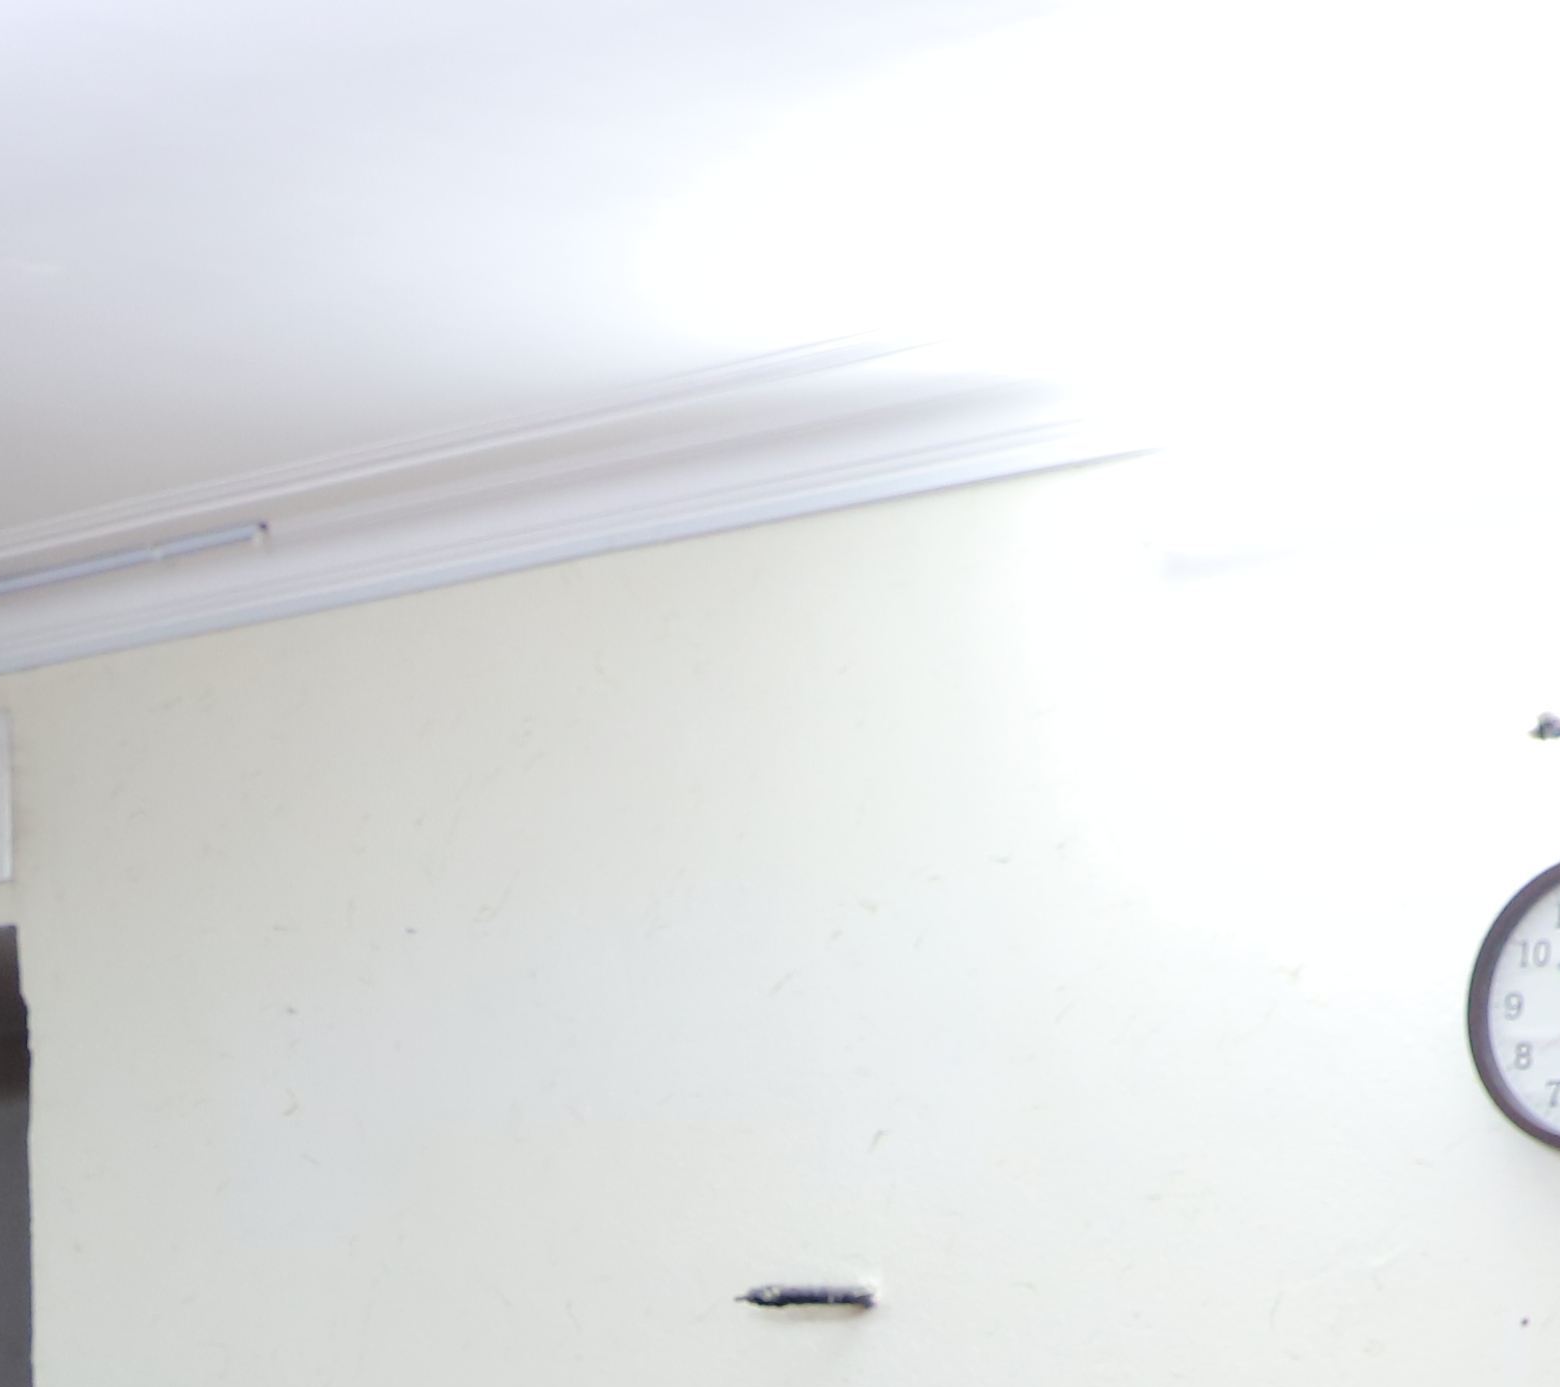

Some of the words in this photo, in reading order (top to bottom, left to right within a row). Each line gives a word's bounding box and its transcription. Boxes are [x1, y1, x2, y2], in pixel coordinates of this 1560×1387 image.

[1518, 939, 1552, 968] 10
[1504, 992, 1524, 1021] 9
[1513, 1043, 1533, 1071] 8
